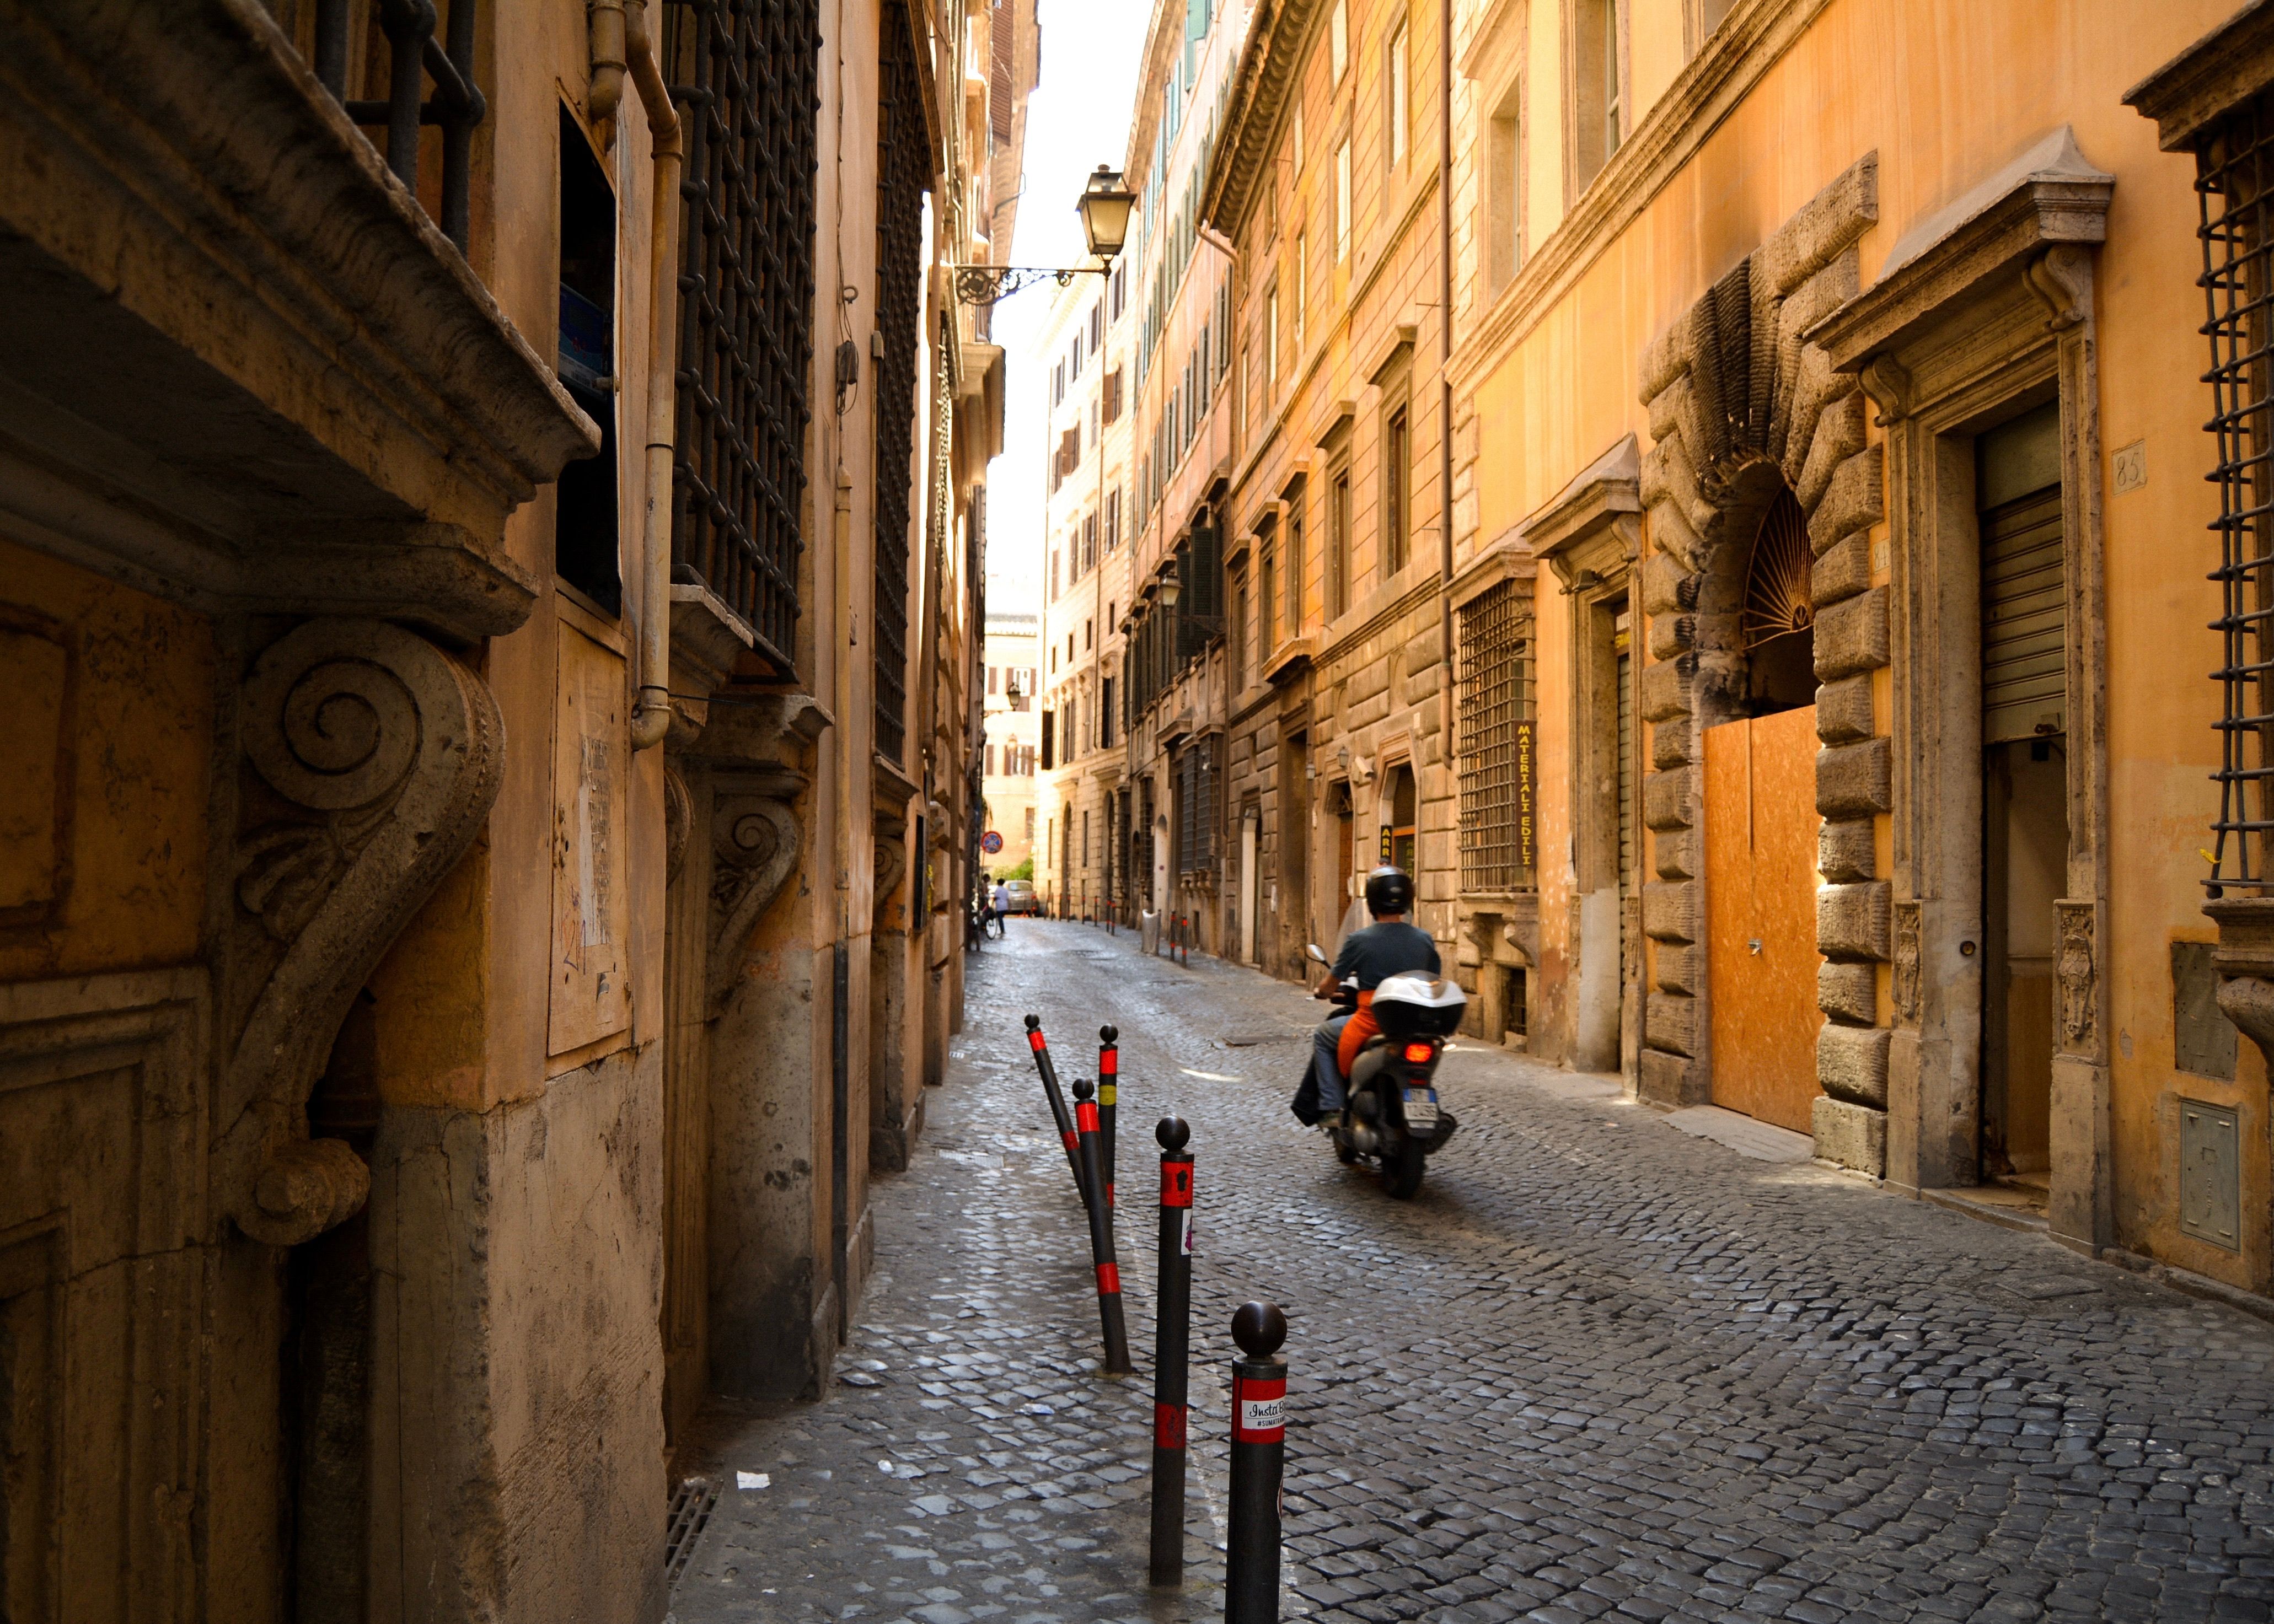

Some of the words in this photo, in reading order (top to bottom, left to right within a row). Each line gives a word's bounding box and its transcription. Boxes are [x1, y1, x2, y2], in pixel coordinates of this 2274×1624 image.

[2117, 452, 2139, 486] 85
[1518, 725, 1531, 812] MATERIALI
[1382, 829, 1390, 856] ARR
[1521, 816, 1531, 865] EDILI
